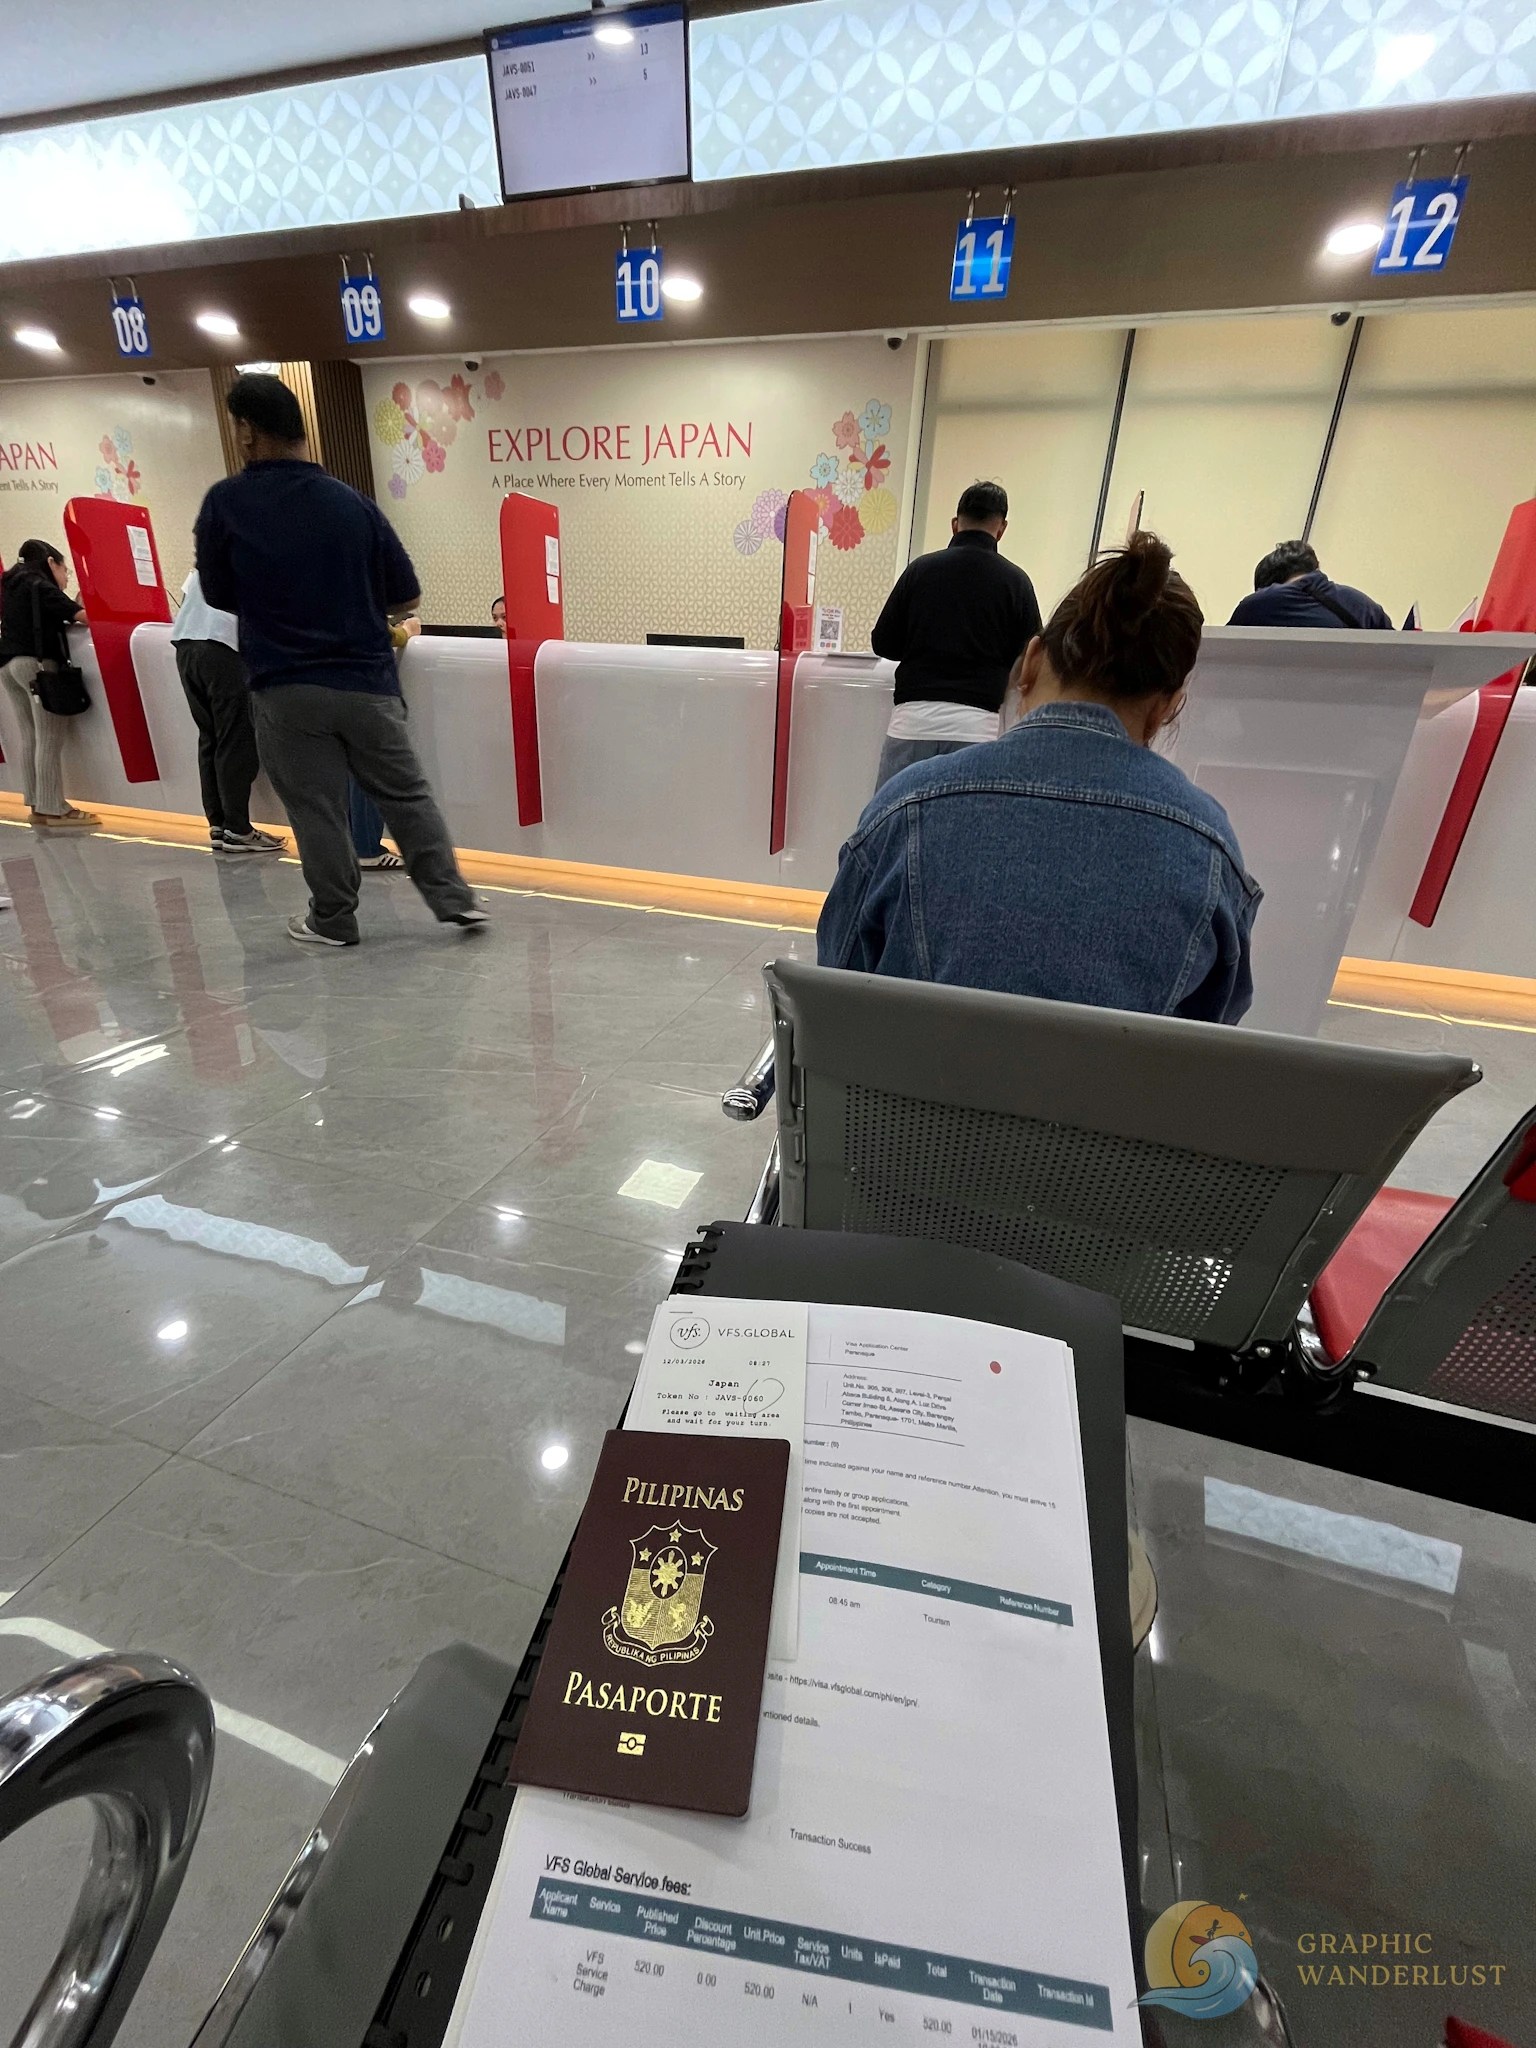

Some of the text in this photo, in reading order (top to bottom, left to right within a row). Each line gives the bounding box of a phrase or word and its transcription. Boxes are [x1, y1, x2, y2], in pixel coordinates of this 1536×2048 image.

[1379, 192, 1458, 268] 12
[954, 230, 1004, 295] 11
[618, 259, 660, 318] 10
[342, 285, 381, 337] 09
[113, 306, 148, 353] 08
[487, 421, 752, 466] EXPLORE JAPAN
[11, 480, 28, 491] Tells
[31, 481, 37, 491] A
[39, 480, 58, 494] Story
[492, 471, 746, 491] A Place Where Every Moment Tells A Story
[718, 1328, 795, 1338] VFS.GLOBAL
[858, 1342, 889, 1350] Application
[708, 1379, 740, 1389] Japan
[657, 1392, 683, 1400] Token
[715, 1394, 764, 1402] JAVS-0060
[693, 1410, 702, 1418] go
[725, 1411, 757, 1419] waiting
[819, 1460, 847, 1469] indicated
[847, 1463, 870, 1473] against
[871, 1467, 885, 1475] your
[886, 1470, 904, 1478] name
[905, 1472, 917, 1480] and
[918, 1475, 947, 1486] reference
[1002, 1492, 1013, 1500] you
[1014, 1495, 1029, 1503] must
[1030, 1498, 1047, 1507] arrive
[621, 1476, 745, 1512] PILIPINAS
[804, 1486, 823, 1494] entire
[824, 1487, 843, 1498] family
[852, 1492, 870, 1502] group
[803, 1496, 821, 1506] along
[822, 1498, 835, 1506] with
[848, 1502, 860, 1511] first
[804, 1508, 825, 1517] copies
[827, 1510, 838, 1518] are
[839, 1512, 850, 1520] not
[815, 1561, 877, 1578] Appointment Time
[921, 1579, 952, 1594] Category
[849, 1601, 861, 1609] am
[999, 1595, 1060, 1617] Reference Number
[923, 1613, 951, 1627] Tourism
[606, 1633, 700, 1663] REPUBLIKA NG PILIPINAS
[562, 1671, 723, 1724] PASAPORTE
[790, 1828, 872, 1855] Transaction Success
[544, 1854, 692, 1896] VFS Global Service fees:
[539, 1888, 579, 1906] Applicant
[589, 1897, 621, 1914] Service
[543, 1903, 568, 1918] Name
[636, 1905, 679, 1925] Published
[644, 1920, 667, 1937] Price
[694, 1916, 733, 1936] Discount
[687, 1930, 737, 1952] Percentage
[797, 1936, 830, 1955] Service
[586, 1950, 605, 1965] VFS
[793, 1950, 832, 1970] Tax/VAT
[841, 1945, 864, 1962] Units
[576, 1962, 609, 1981] Service
[634, 1959, 665, 1977] 520.00
[926, 1962, 948, 1978] Total
[573, 1978, 606, 1997] Charge
[744, 1981, 775, 1999] 520.00
[969, 1970, 1017, 1992] Transaction
[802, 1993, 819, 2008] N/A
[983, 1987, 1004, 2004] Date
[1037, 1984, 1095, 2008] Transaction Id
[879, 2007, 895, 2024] Yes
